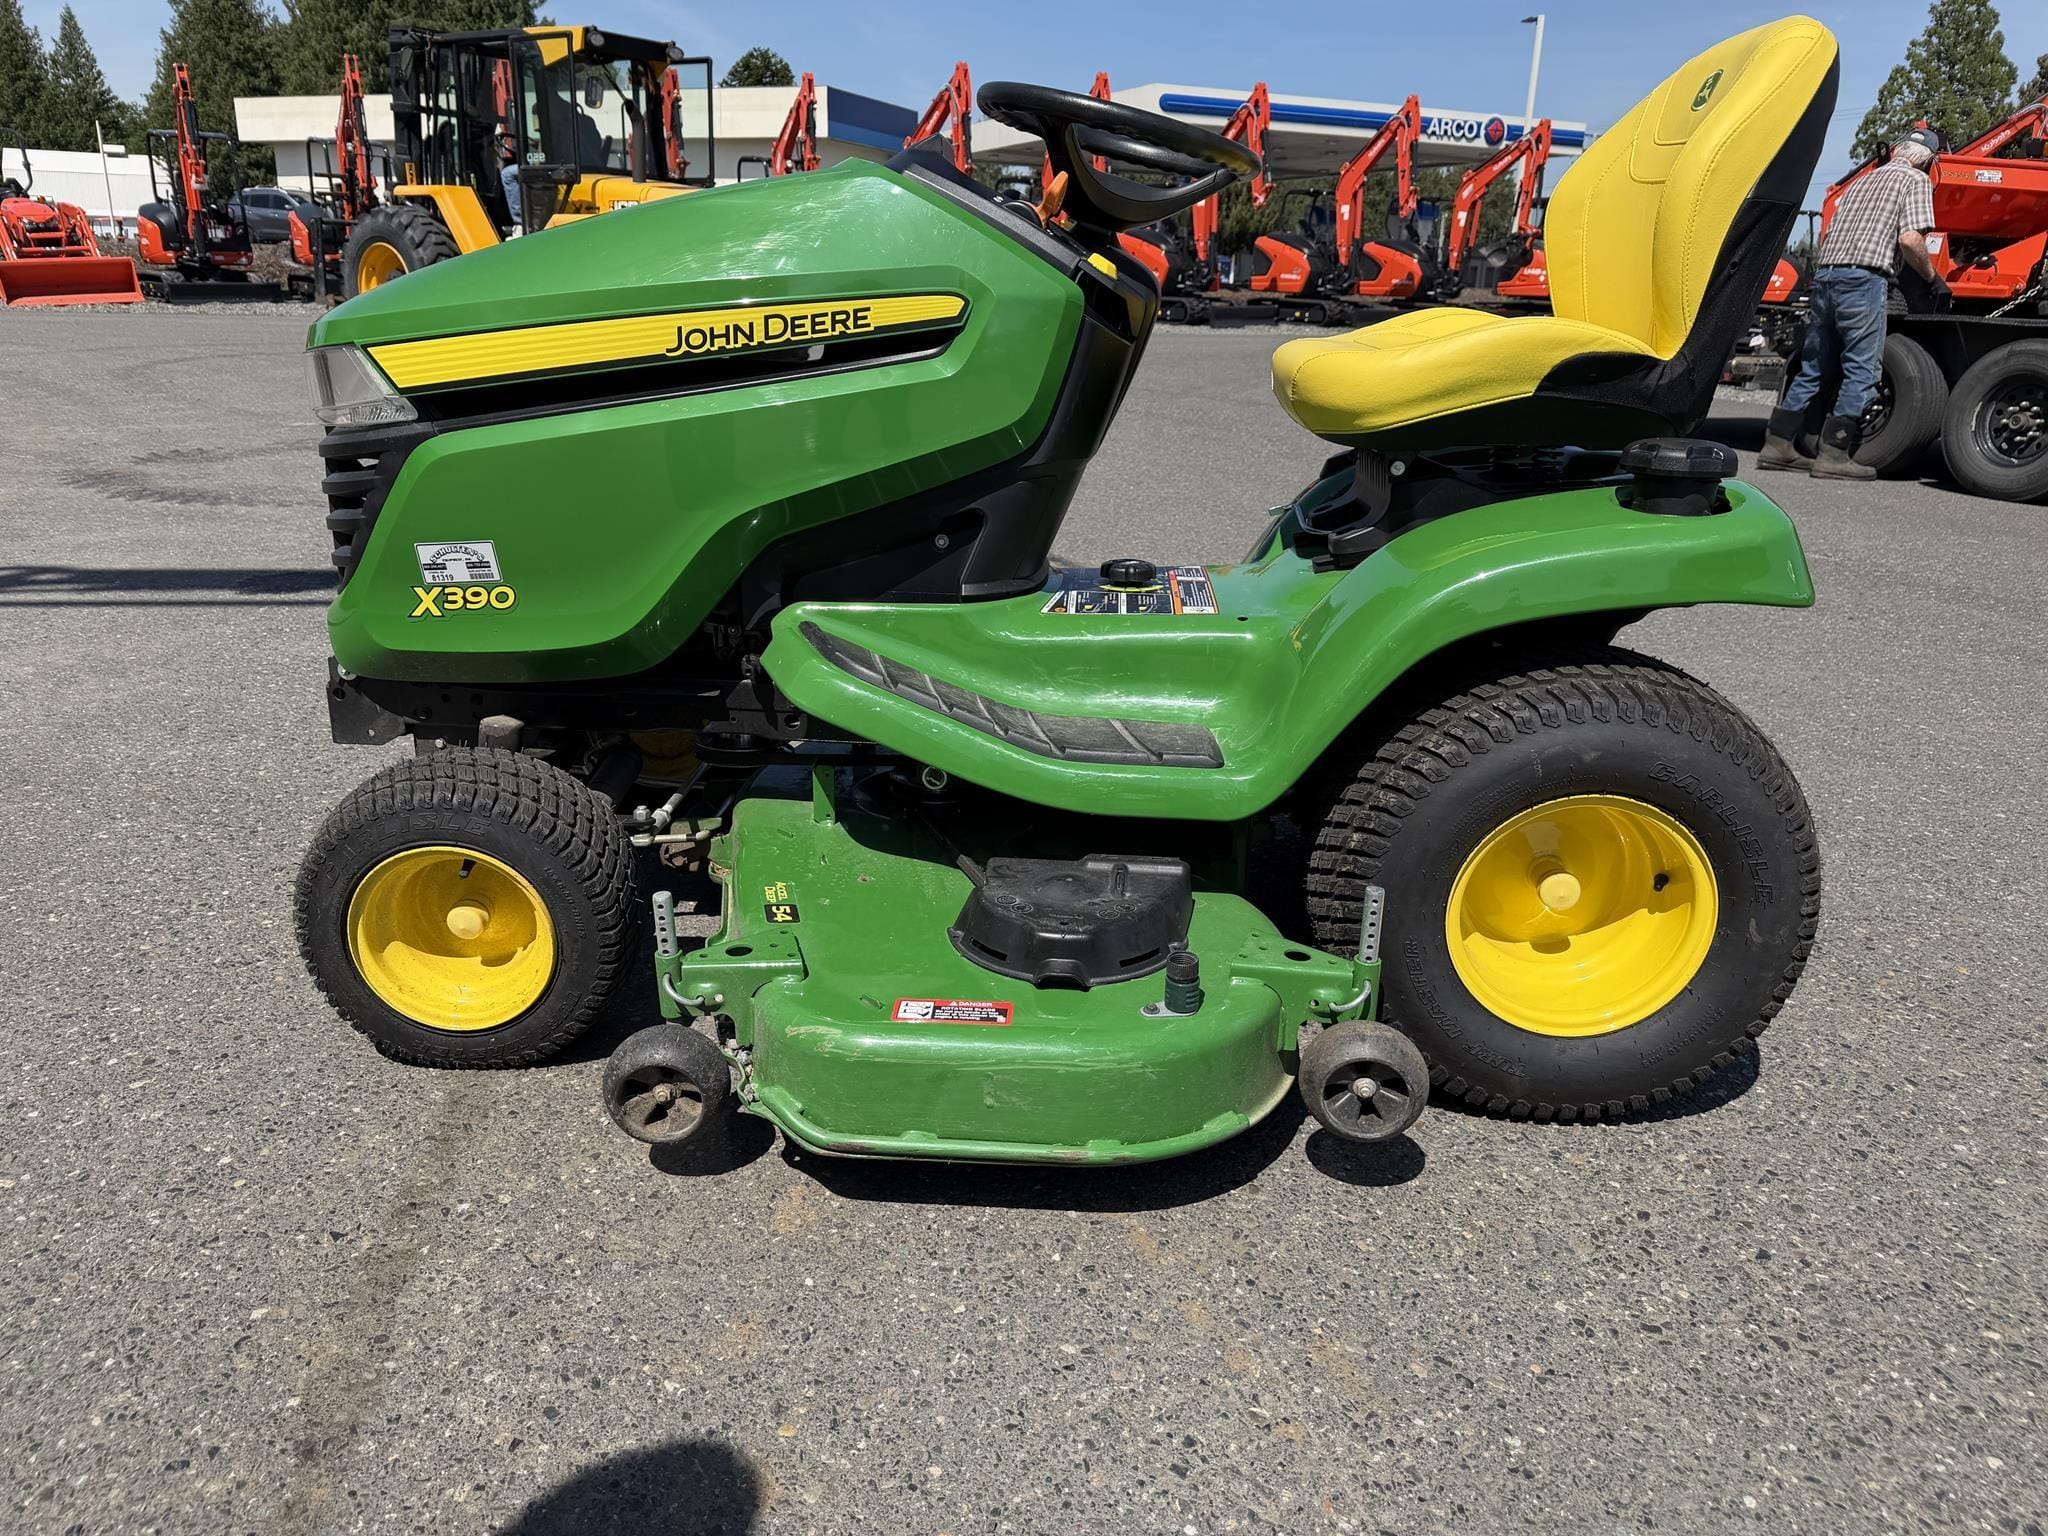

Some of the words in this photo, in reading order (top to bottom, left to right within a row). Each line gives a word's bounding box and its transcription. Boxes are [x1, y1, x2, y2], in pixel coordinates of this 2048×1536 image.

[1426, 117, 1478, 139] ARCO
[1980, 128, 2012, 152] Kubota
[665, 321, 755, 354] JOHN
[763, 306, 871, 341] DEERE
[432, 573, 455, 581] 81319
[410, 585, 516, 617] X390
[1648, 761, 1774, 905] CARLISLE
[771, 905, 793, 923] 54
[1404, 936, 1463, 1039] MASTER
[1462, 1040, 1528, 1078] TURF
